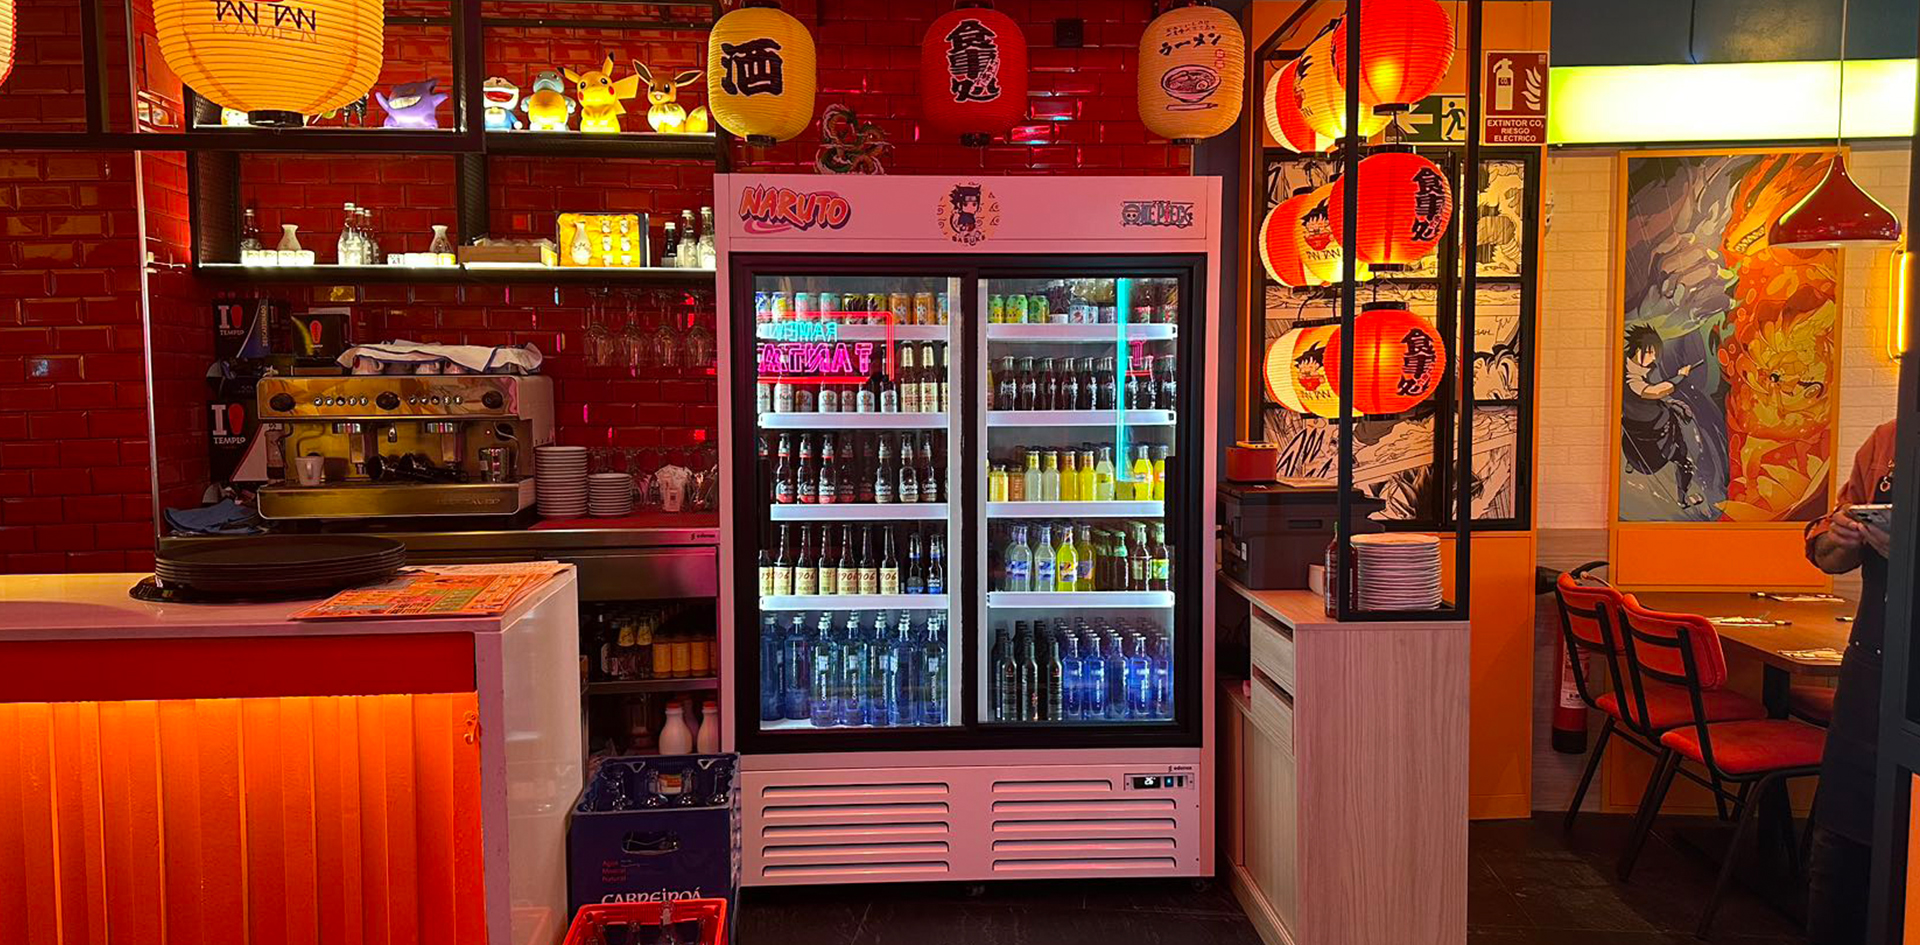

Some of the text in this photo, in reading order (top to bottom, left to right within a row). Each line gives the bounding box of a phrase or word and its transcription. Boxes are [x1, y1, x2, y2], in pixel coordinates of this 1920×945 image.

[210, 0, 316, 31] TAN TAN
[1159, 32, 1221, 56] ラーメン
[720, 38, 784, 97] 酒
[1487, 119, 1528, 127] EXTINTOR
[1501, 127, 1530, 135] RIESGO
[739, 184, 851, 231] NARUTO
[1321, 248, 1341, 259] TAN
[213, 436, 246, 444] TEMPLO
